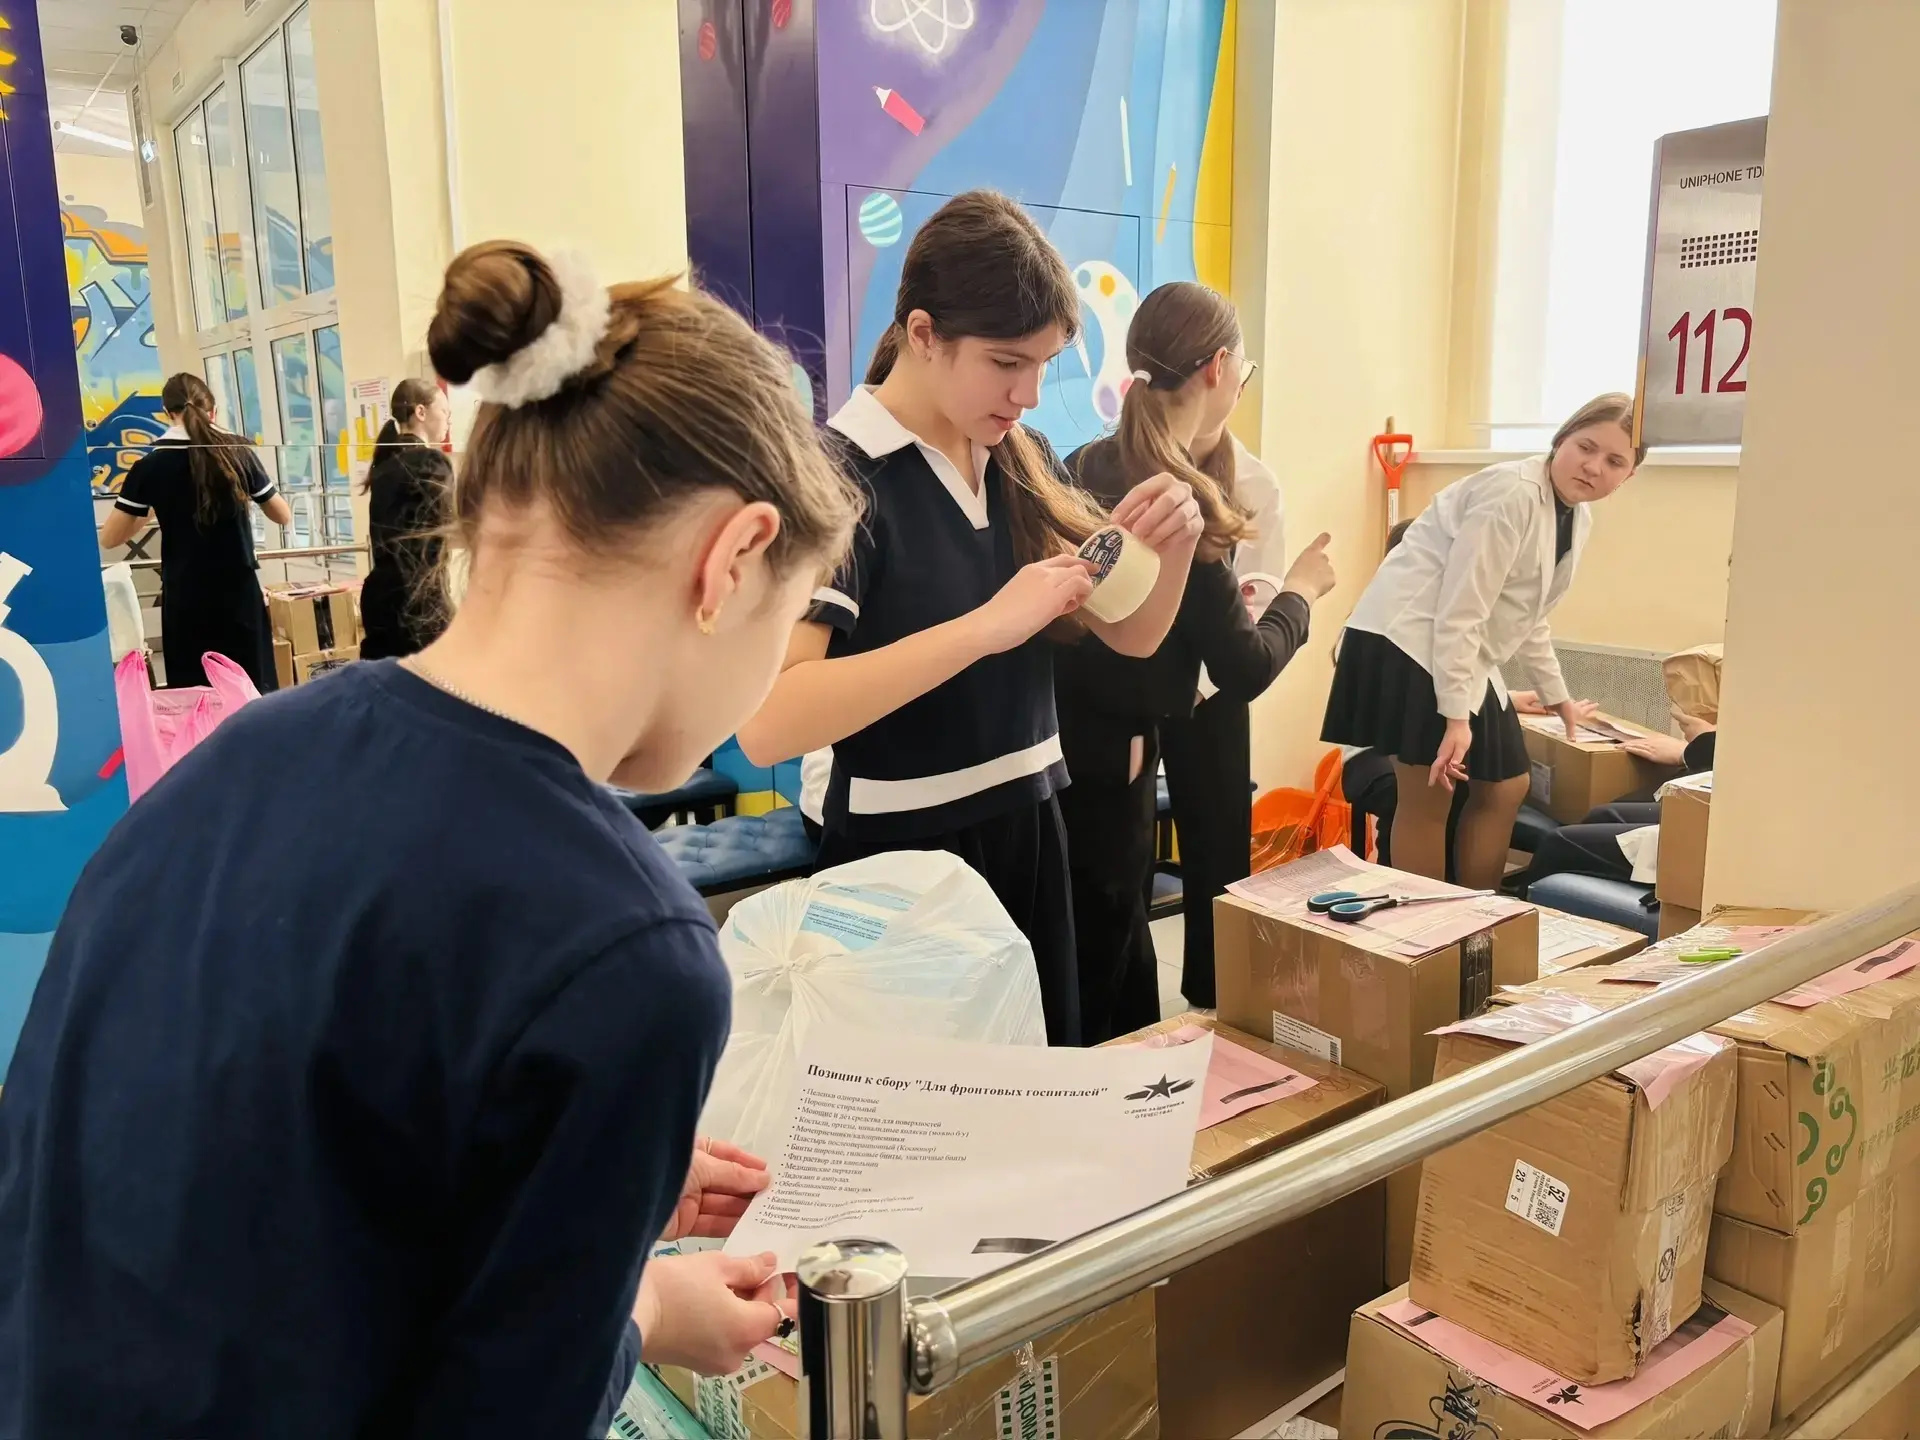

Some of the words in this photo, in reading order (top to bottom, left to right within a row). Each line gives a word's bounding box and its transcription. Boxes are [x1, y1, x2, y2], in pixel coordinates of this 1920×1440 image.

[1680, 169, 1743, 189] UNIPHONE
[1746, 165, 1765, 179] TD
[1667, 307, 1753, 395] 112
[807, 1064, 862, 1085] Позиции
[864, 1077, 874, 1085] к
[876, 1077, 911, 1091] сбору
[915, 1079, 947, 1092] "Для
[950, 1084, 1023, 1097] фронтовых
[1026, 1087, 1108, 1097] госпиталей"
[806, 1088, 836, 1100] Пеленки
[837, 1094, 880, 1105] одноразовые
[804, 1097, 835, 1109] Порошок
[836, 1103, 877, 1114] стиральный
[801, 1106, 832, 1119] Моющие
[895, 1118, 942, 1128] поверхностей
[900, 1128, 928, 1136] коляски
[793, 1134, 826, 1145] Пластырь
[790, 1144, 813, 1153] Бинты
[784, 1163, 831, 1174] Медицинские
[831, 1168, 863, 1176] перчатки
[1515, 1168, 1526, 1183] 23
[782, 1172, 815, 1182] Лидокаин
[775, 1188, 820, 1198] Антибиотики
[1510, 1194, 1519, 1203] 5
[1548, 1185, 1566, 1203] 52
[762, 1211, 799, 1221] Мусорные
[759, 1218, 788, 1229] Тапочки
